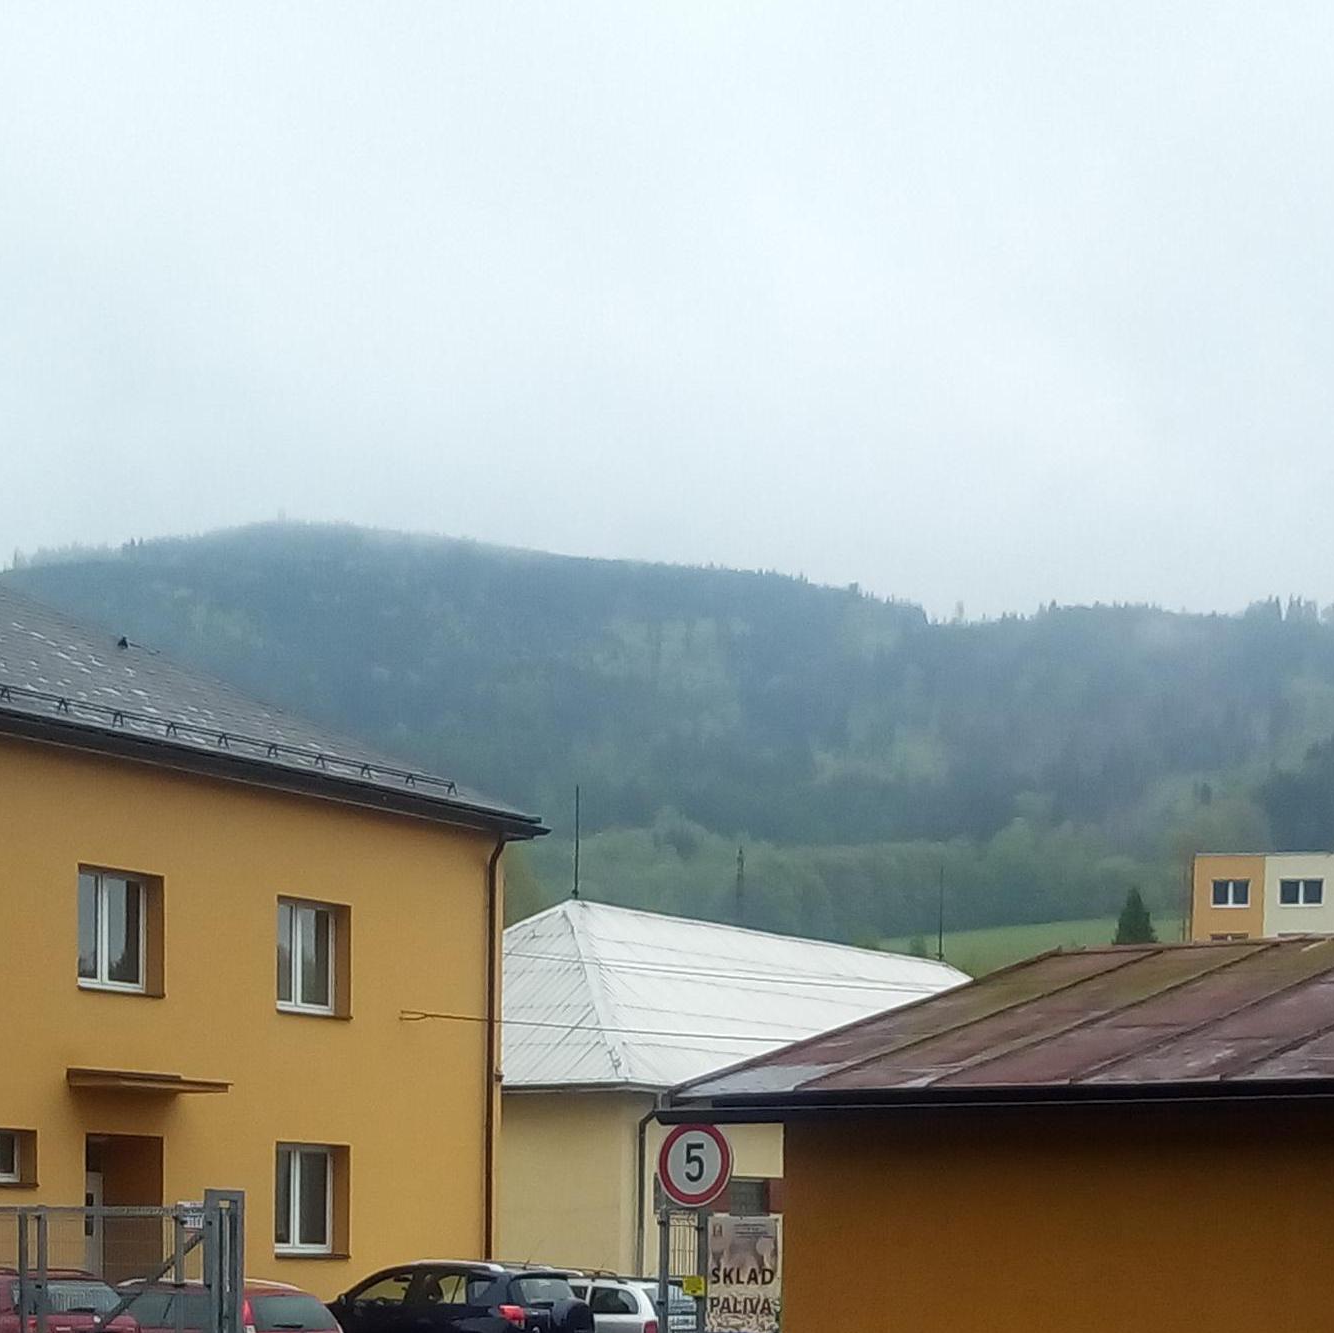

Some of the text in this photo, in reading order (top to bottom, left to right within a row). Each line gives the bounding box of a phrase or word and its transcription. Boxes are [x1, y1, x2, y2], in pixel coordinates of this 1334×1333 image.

[684, 1143, 705, 1183] 5
[711, 1267, 775, 1285] SKLAD
[709, 1296, 772, 1315] PALIVA
